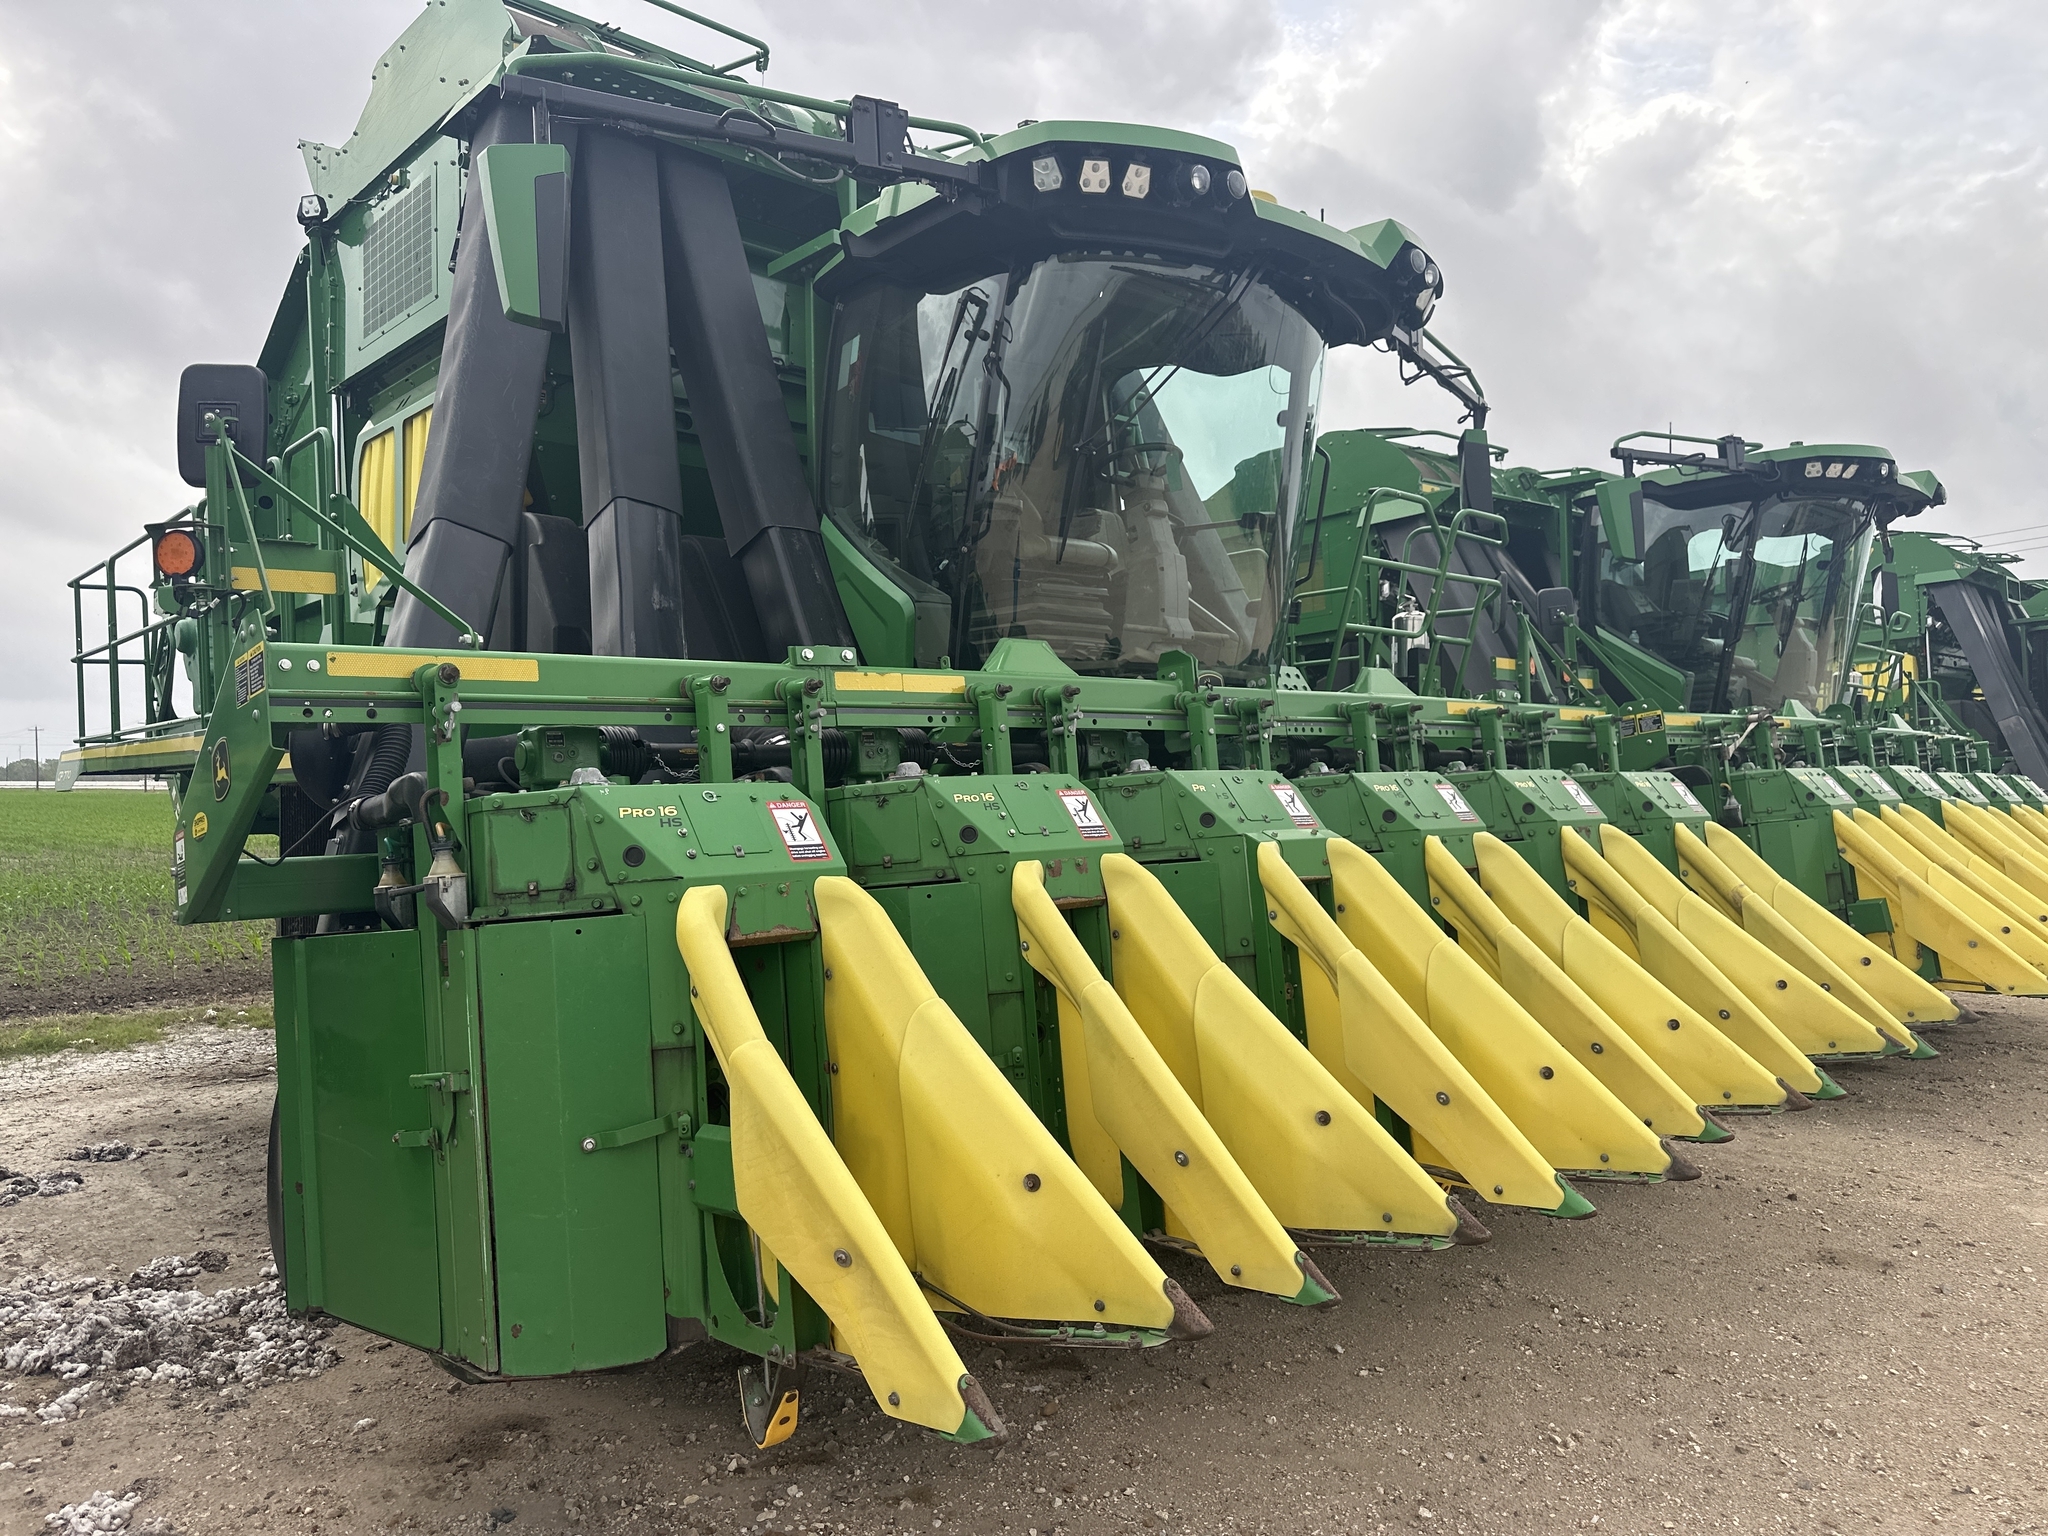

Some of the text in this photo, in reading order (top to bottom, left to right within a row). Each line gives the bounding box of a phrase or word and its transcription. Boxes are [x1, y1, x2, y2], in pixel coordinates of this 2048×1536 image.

[979, 792, 995, 802] 16
[657, 805, 678, 817] 16
[983, 802, 1001, 811] HS
[660, 817, 683, 828] HS
